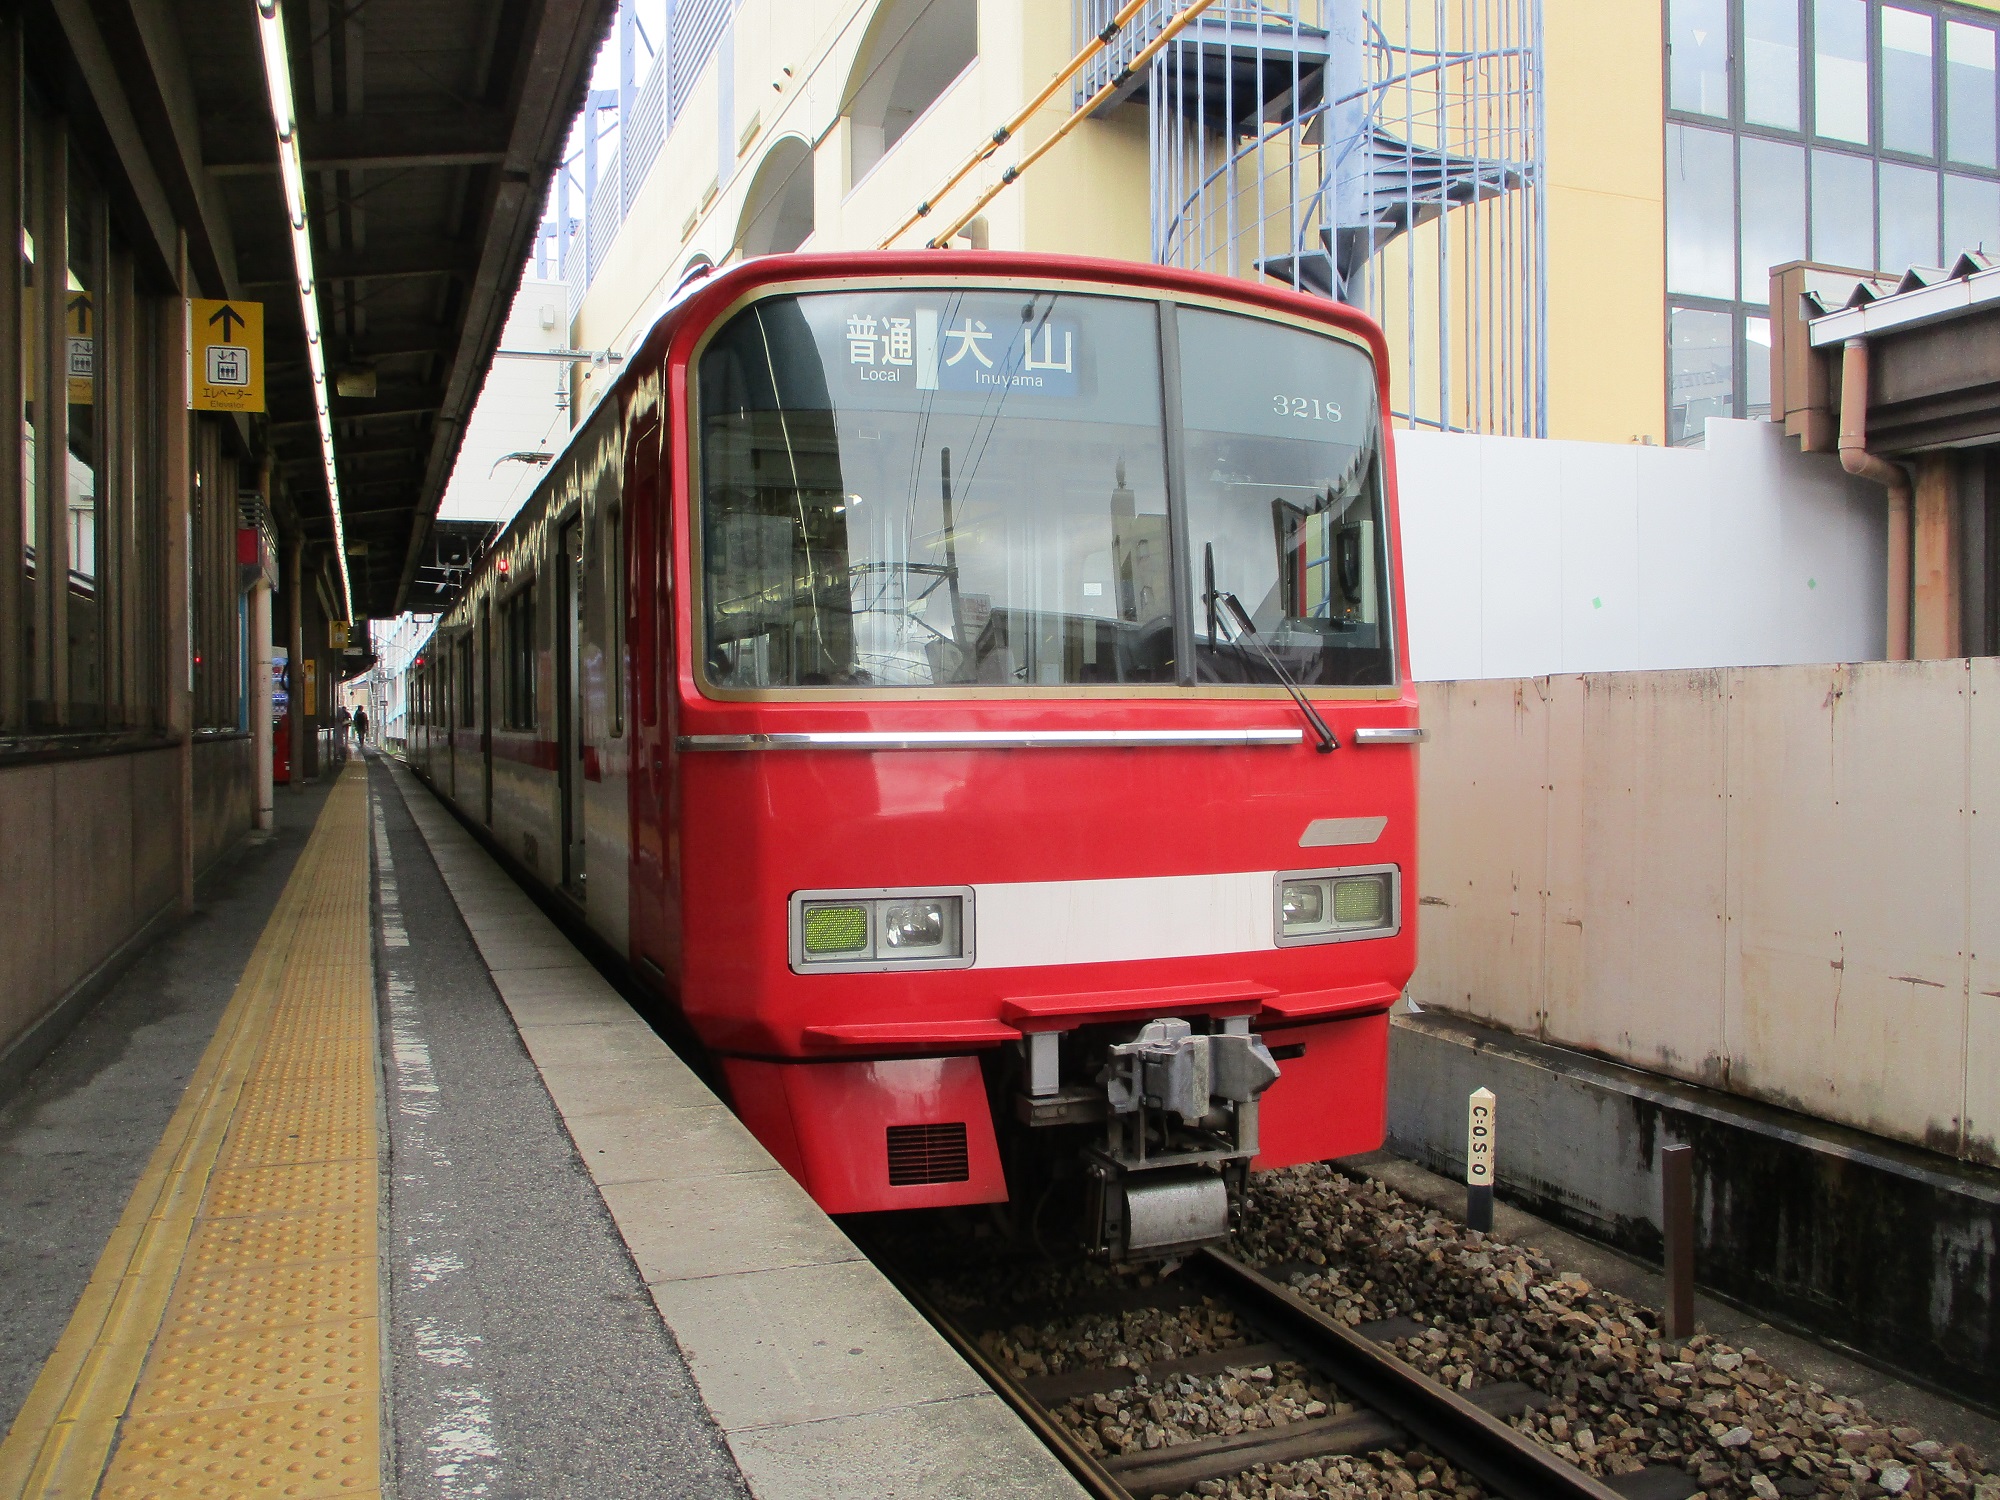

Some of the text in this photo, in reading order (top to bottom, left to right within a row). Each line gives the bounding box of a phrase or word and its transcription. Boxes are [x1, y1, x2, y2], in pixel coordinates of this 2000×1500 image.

[846, 313, 913, 366] 普通
[860, 366, 1044, 388] Local Inuyama
[203, 388, 253, 400] エレベーター
[210, 400, 245, 409] Elevator
[1272, 394, 1343, 423] 3218
